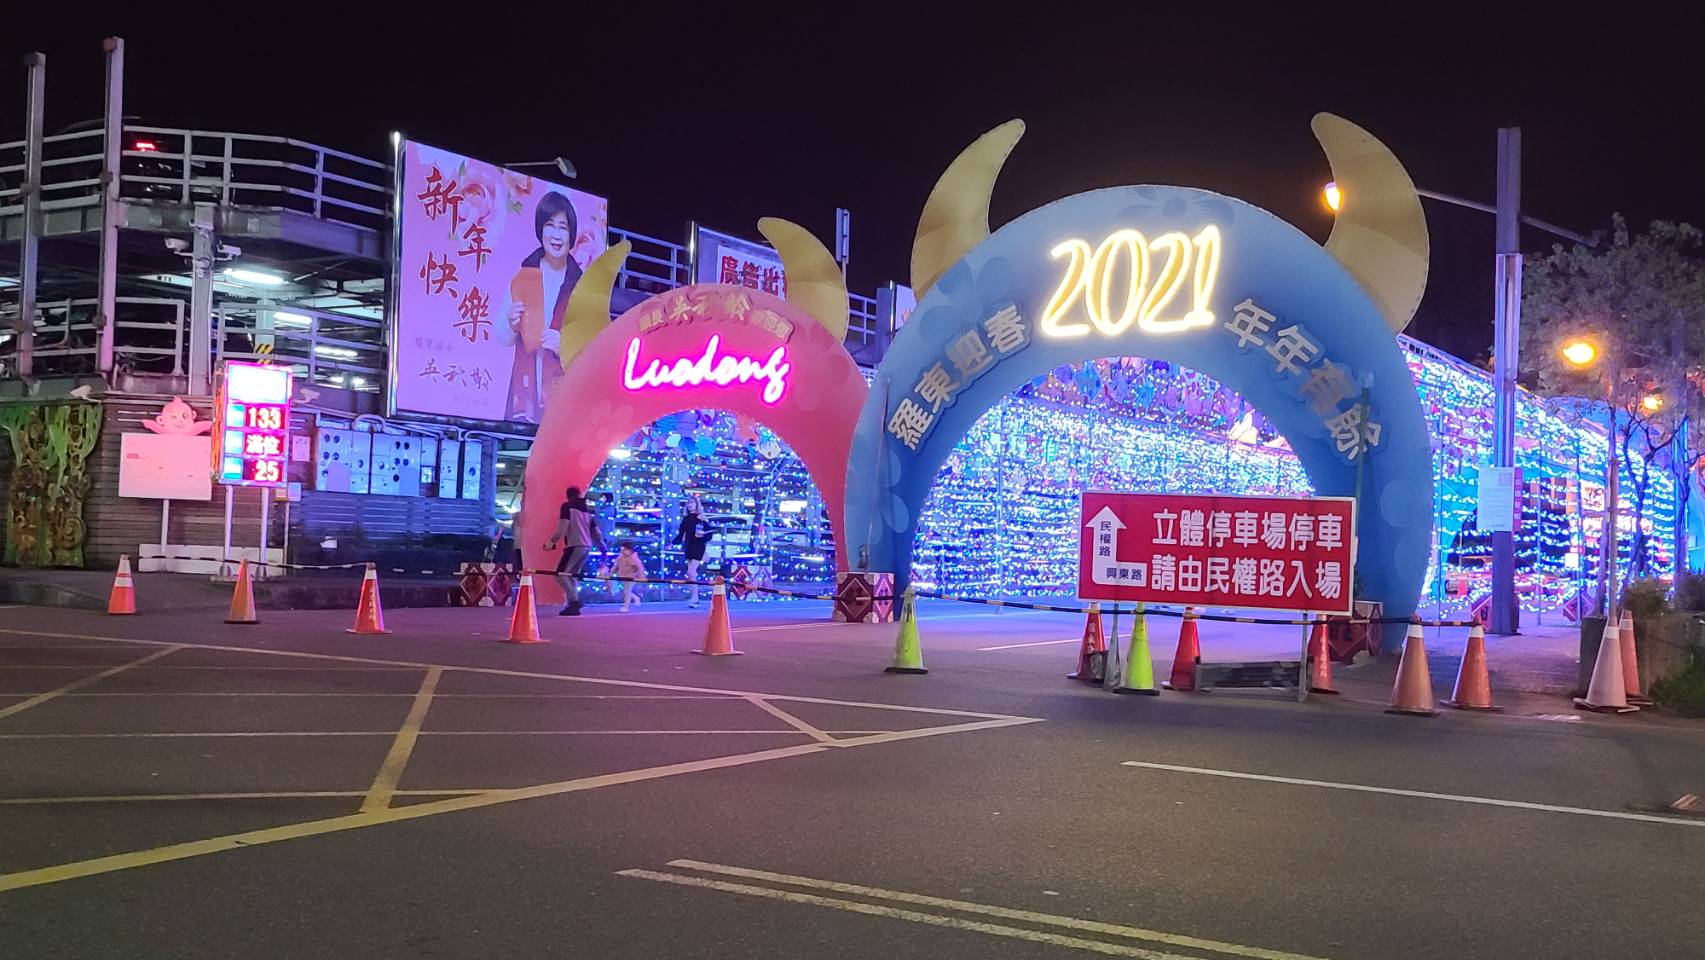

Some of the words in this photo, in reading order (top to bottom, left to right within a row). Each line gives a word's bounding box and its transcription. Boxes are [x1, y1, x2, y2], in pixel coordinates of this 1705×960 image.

[720, 255, 787, 297] 廣告出
[1041, 224, 1221, 337] 2021
[624, 334, 791, 403] Luodong
[888, 304, 1026, 450] 羅東迎春
[1224, 298, 1381, 460] 年年有餘
[248, 407, 281, 430] 133
[255, 459, 279, 482] 25
[1098, 520, 1112, 557] 民權路
[1152, 508, 1343, 552] 立體停車場停車
[1106, 567, 1142, 582] 興東路
[1151, 553, 1342, 600] 請由民權路入場
